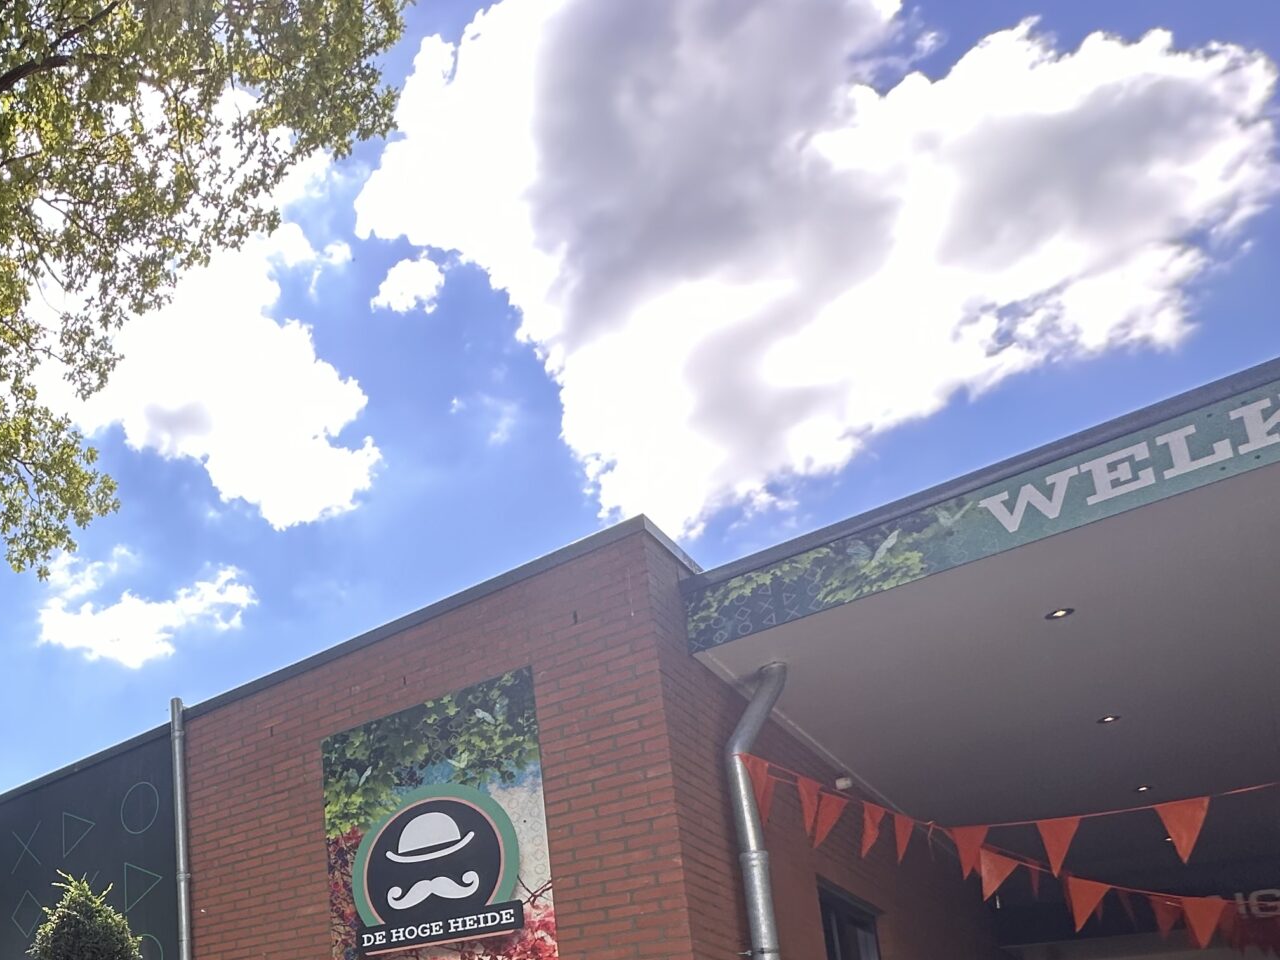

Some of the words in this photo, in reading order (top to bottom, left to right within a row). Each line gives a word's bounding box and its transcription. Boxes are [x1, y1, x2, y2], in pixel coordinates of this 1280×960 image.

[361, 931, 387, 948] DE
[390, 920, 444, 943] HOGE
[447, 908, 515, 936] HEIDE
